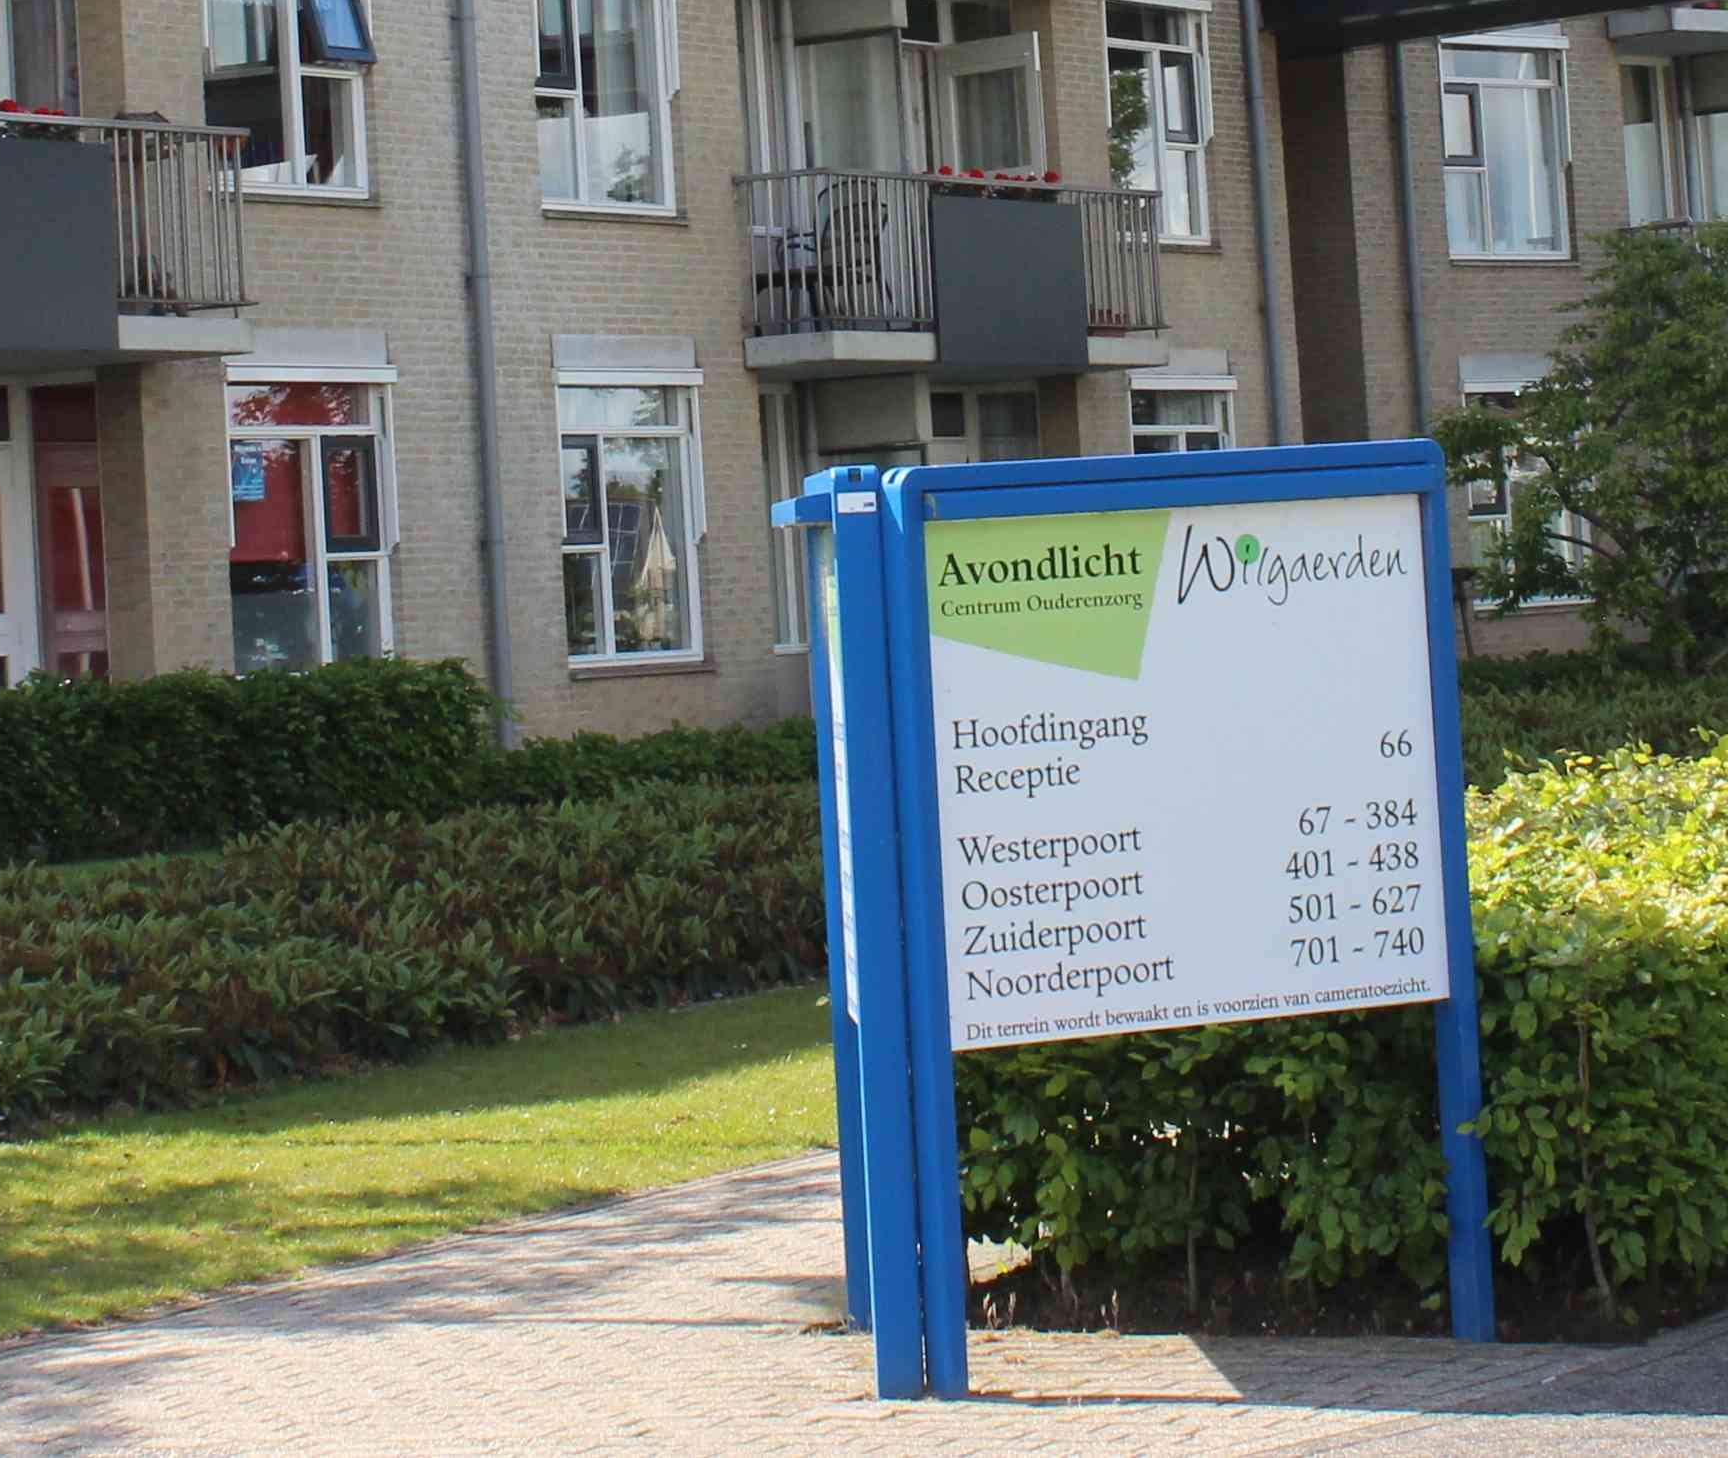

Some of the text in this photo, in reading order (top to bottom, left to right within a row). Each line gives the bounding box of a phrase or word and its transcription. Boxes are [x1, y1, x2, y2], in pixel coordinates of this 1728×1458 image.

[937, 544, 1143, 587] Avondlicht
[1178, 524, 1408, 606] Wilgaerden
[940, 590, 1144, 618] Centrum Ouderenzorg
[952, 710, 1149, 750] Hoofdingang
[1379, 728, 1413, 759] 66
[954, 756, 1081, 798] Receptie
[1298, 805, 1332, 837] 67
[1365, 798, 1418, 831] 384
[957, 827, 1142, 868] Westerpoort
[1285, 849, 1335, 880] 401
[1368, 841, 1419, 872] 438
[961, 870, 1144, 912] Oosterpoort
[1288, 892, 1337, 924] 501
[1372, 884, 1422, 916] 627
[963, 914, 1148, 956] Zuiderpoort
[1290, 936, 1340, 967] 701
[1374, 926, 1425, 959] 740
[965, 955, 1175, 1001] Noorderpoort
[966, 976, 1431, 1041] Dit terrein wordt bewaakt en is voorzien van cameratoezicht.
